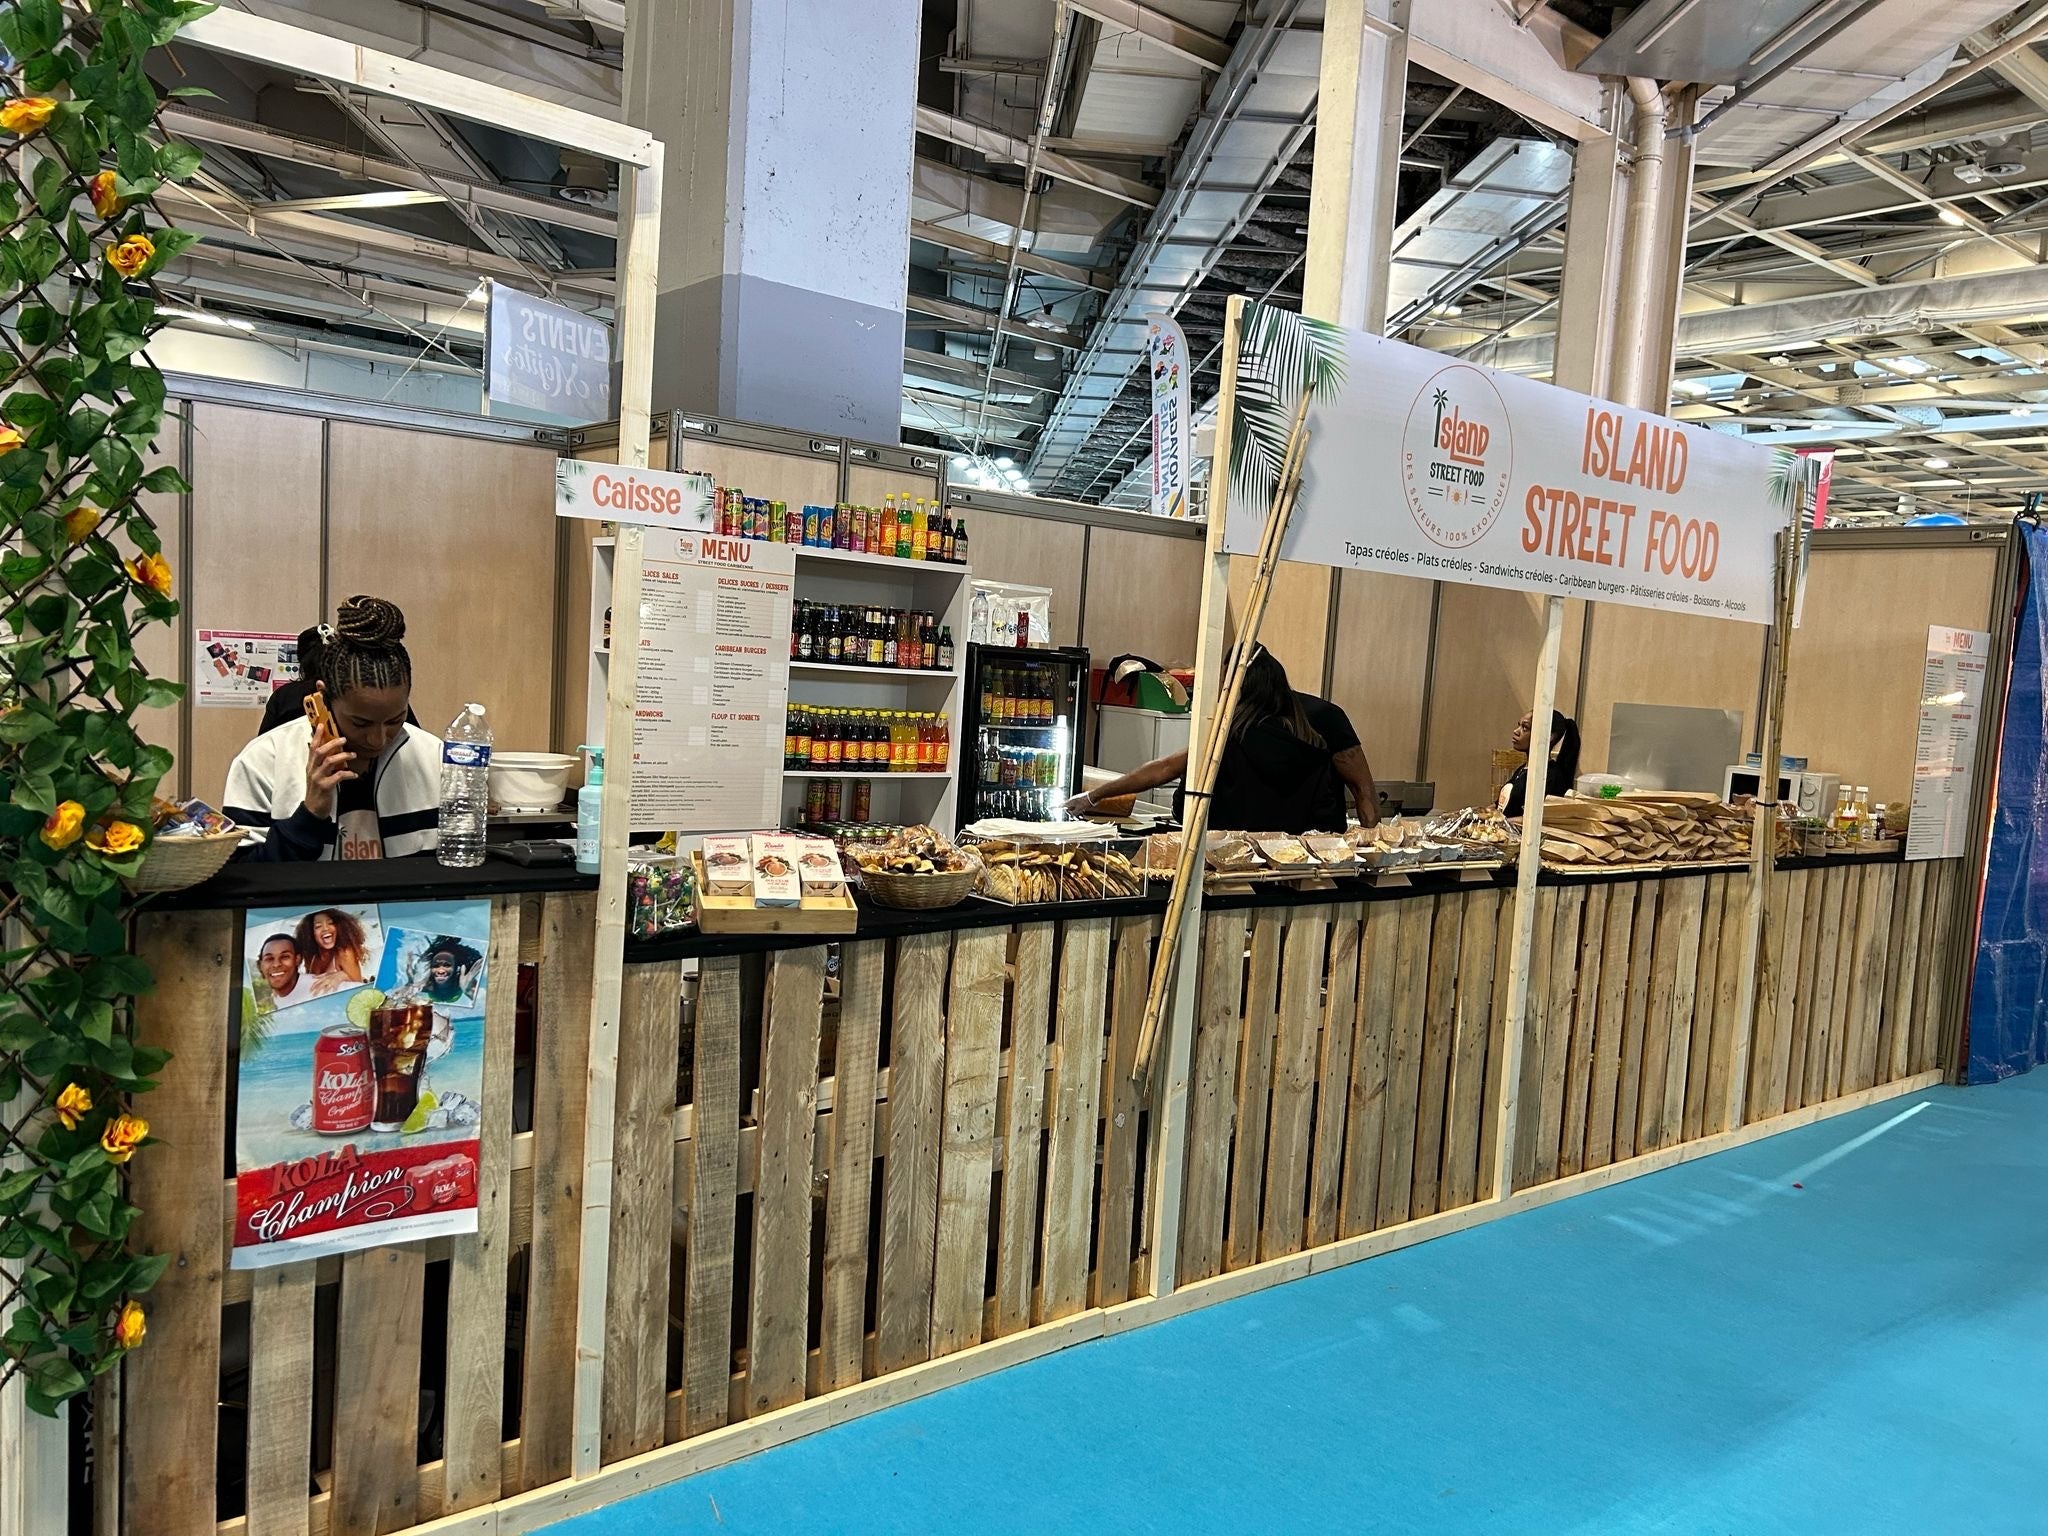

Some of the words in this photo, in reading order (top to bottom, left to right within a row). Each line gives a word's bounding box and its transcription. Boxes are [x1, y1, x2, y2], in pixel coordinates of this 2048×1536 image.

[1405, 452, 1414, 481] DES
[1581, 407, 1688, 495] ISLAND
[1430, 461, 1462, 483] STREET
[1463, 469, 1485, 487] FOOD
[592, 474, 681, 515] Caisse
[1409, 487, 1442, 537] SAVEURS
[1471, 472, 1508, 536] EXOTIQUES
[701, 538, 751, 562] MENU
[1444, 531, 1468, 541] 100%
[1521, 484, 1637, 569] STREET
[1643, 509, 1720, 582] FOOD
[1344, 541, 1373, 558] Tapas
[1375, 547, 1409, 563] créoles
[1417, 552, 1439, 567] Plats
[1441, 557, 1472, 572] créoles
[1479, 562, 1524, 579] Sandwichs
[1525, 567, 1553, 583] créoles
[1559, 573, 1597, 590] Caribbean
[1598, 579, 1625, 594] burgers
[1630, 584, 1665, 600] Pâtisseries
[1666, 590, 1688, 603] créoles
[1693, 594, 1720, 608] Boissons
[1724, 599, 1746, 611] Alcools
[1953, 631, 1974, 649] MENU
[635, 710, 663, 718] ANDWICHS
[318, 1069, 369, 1089] KOLA
[268, 1144, 361, 1200] KOLA
[433, 1181, 456, 1194] KOLA
[248, 1166, 410, 1240] Champion
